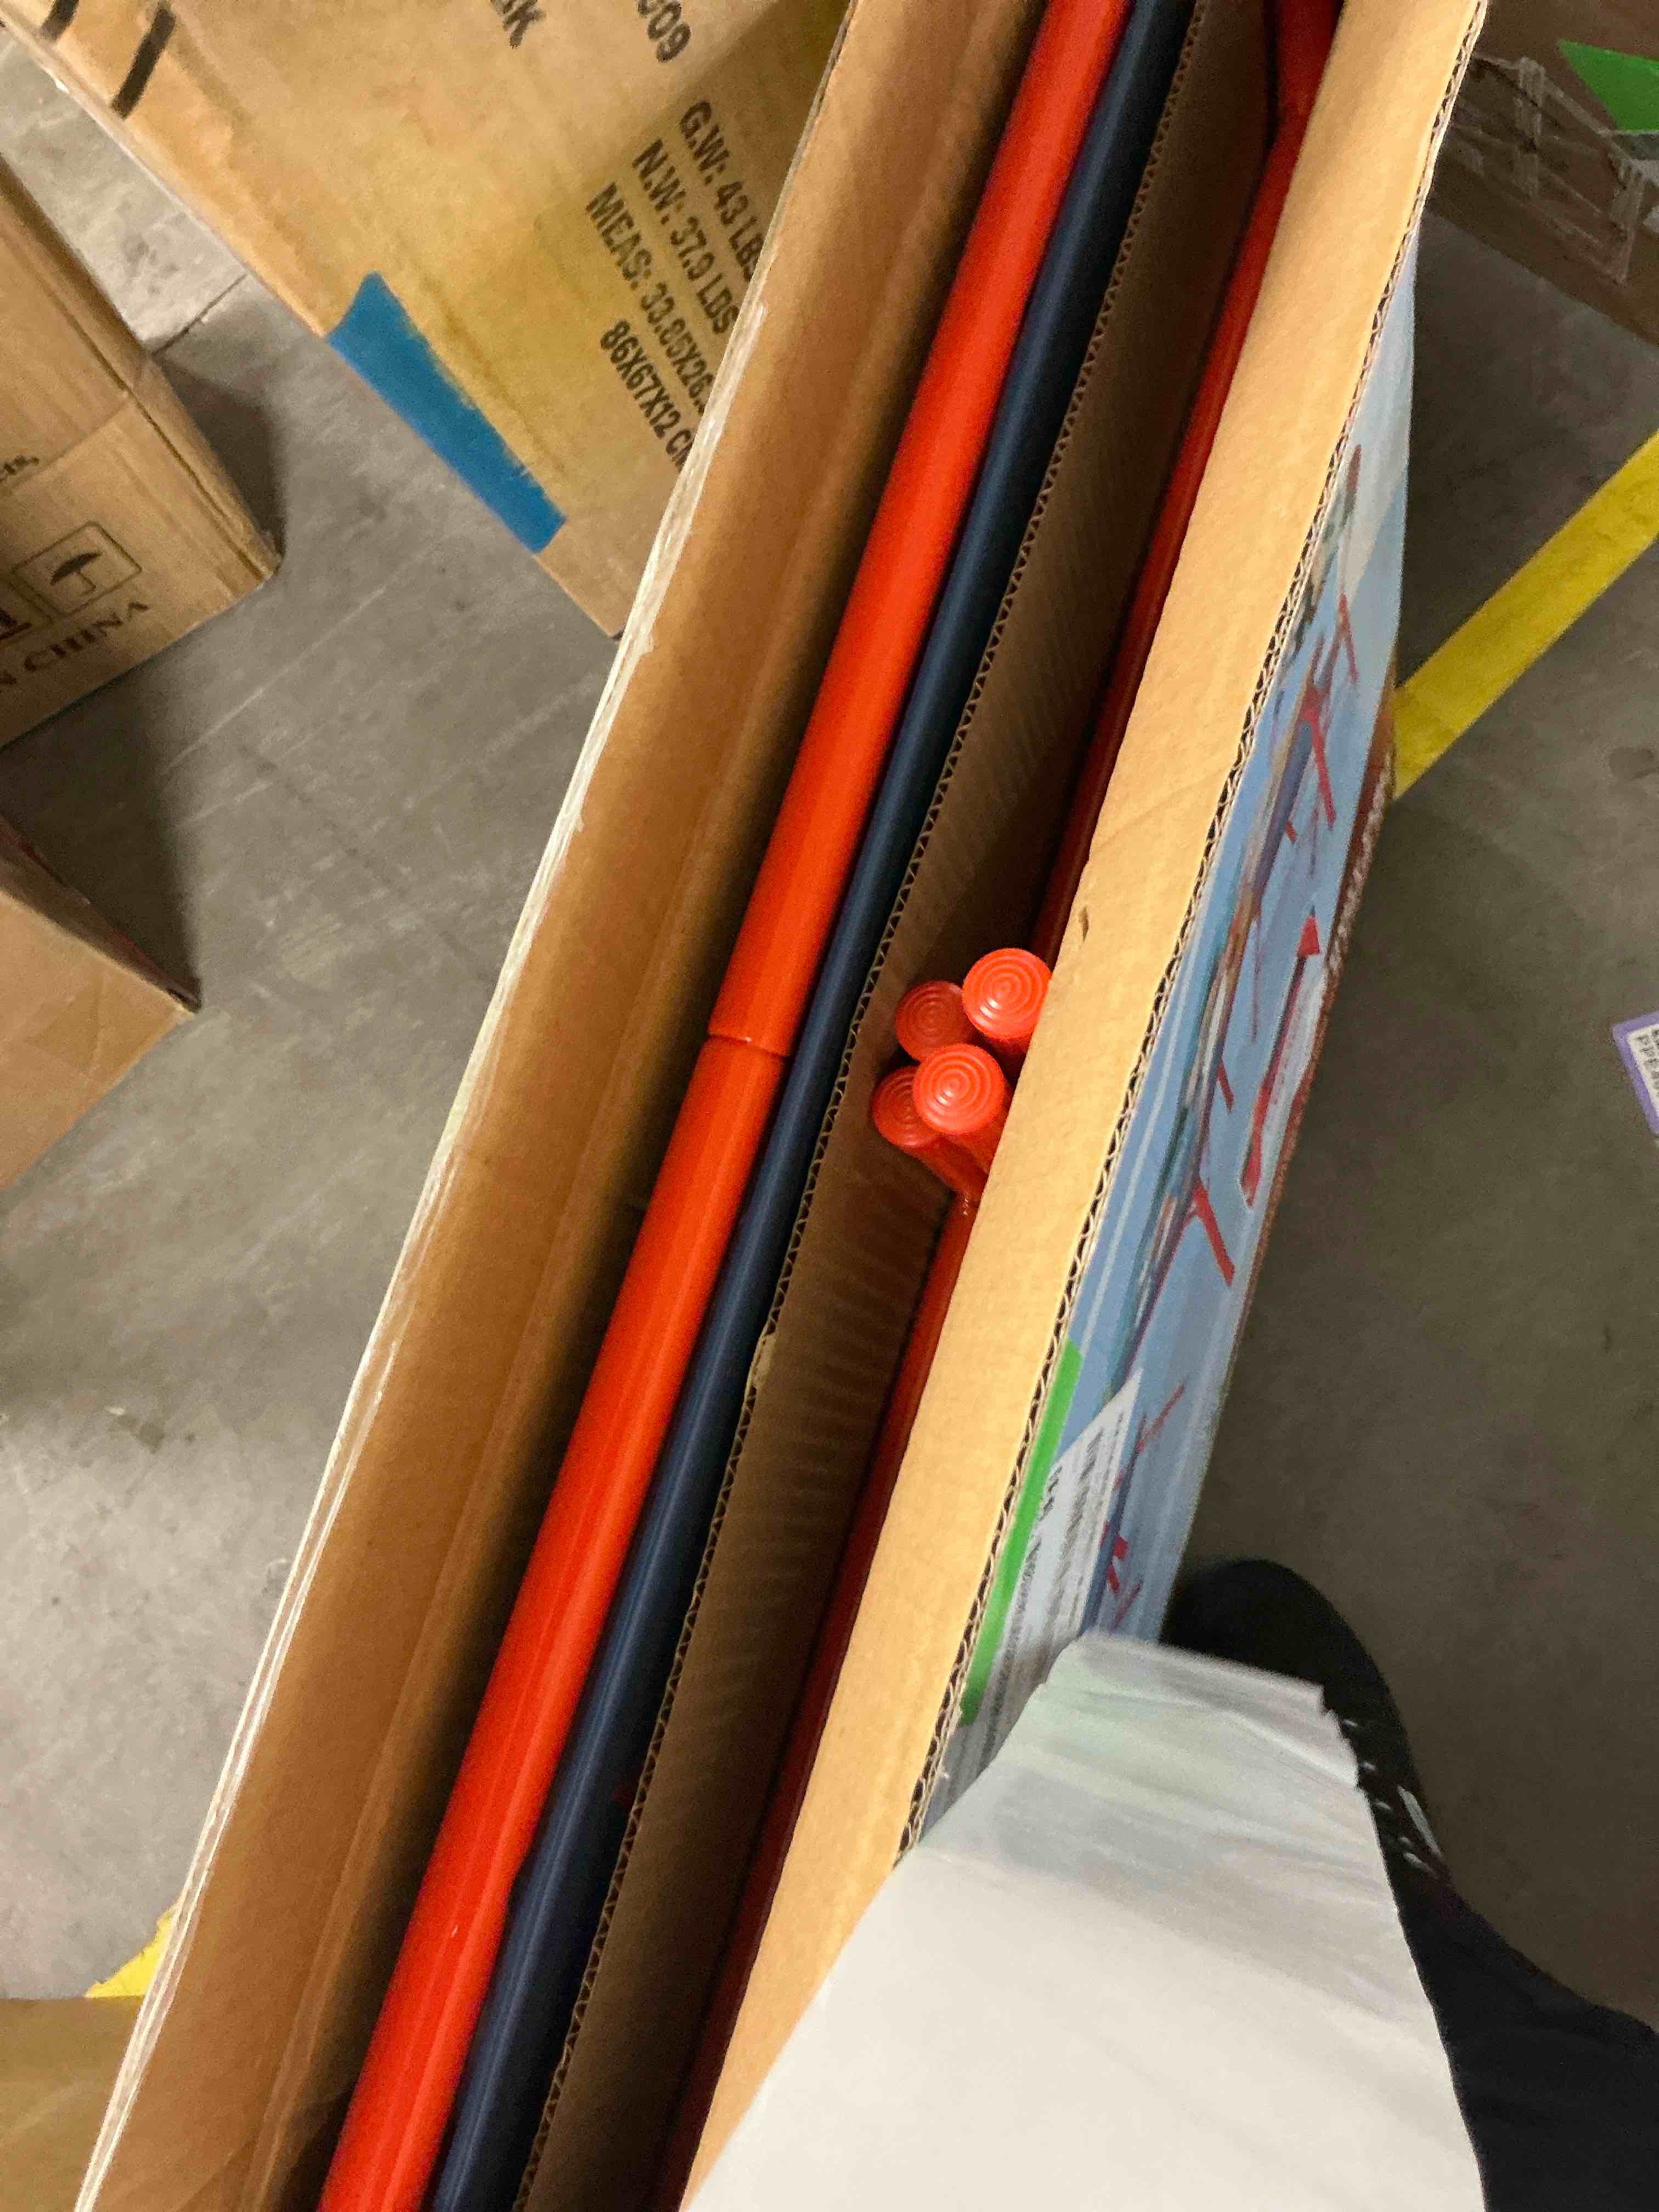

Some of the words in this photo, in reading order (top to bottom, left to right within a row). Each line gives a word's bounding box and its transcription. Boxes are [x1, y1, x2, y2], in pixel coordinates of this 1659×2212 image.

[490, 0, 546, 48] K
[632, 138, 686, 225] N.W:
[670, 216, 714, 282] 37.9
[680, 100, 729, 185] G.W:
[714, 180, 748, 226] 43
[586, 181, 652, 291] MEAS:
[640, 281, 714, 416] 33.85X26.
[600, 319, 681, 439] 86X67X12
